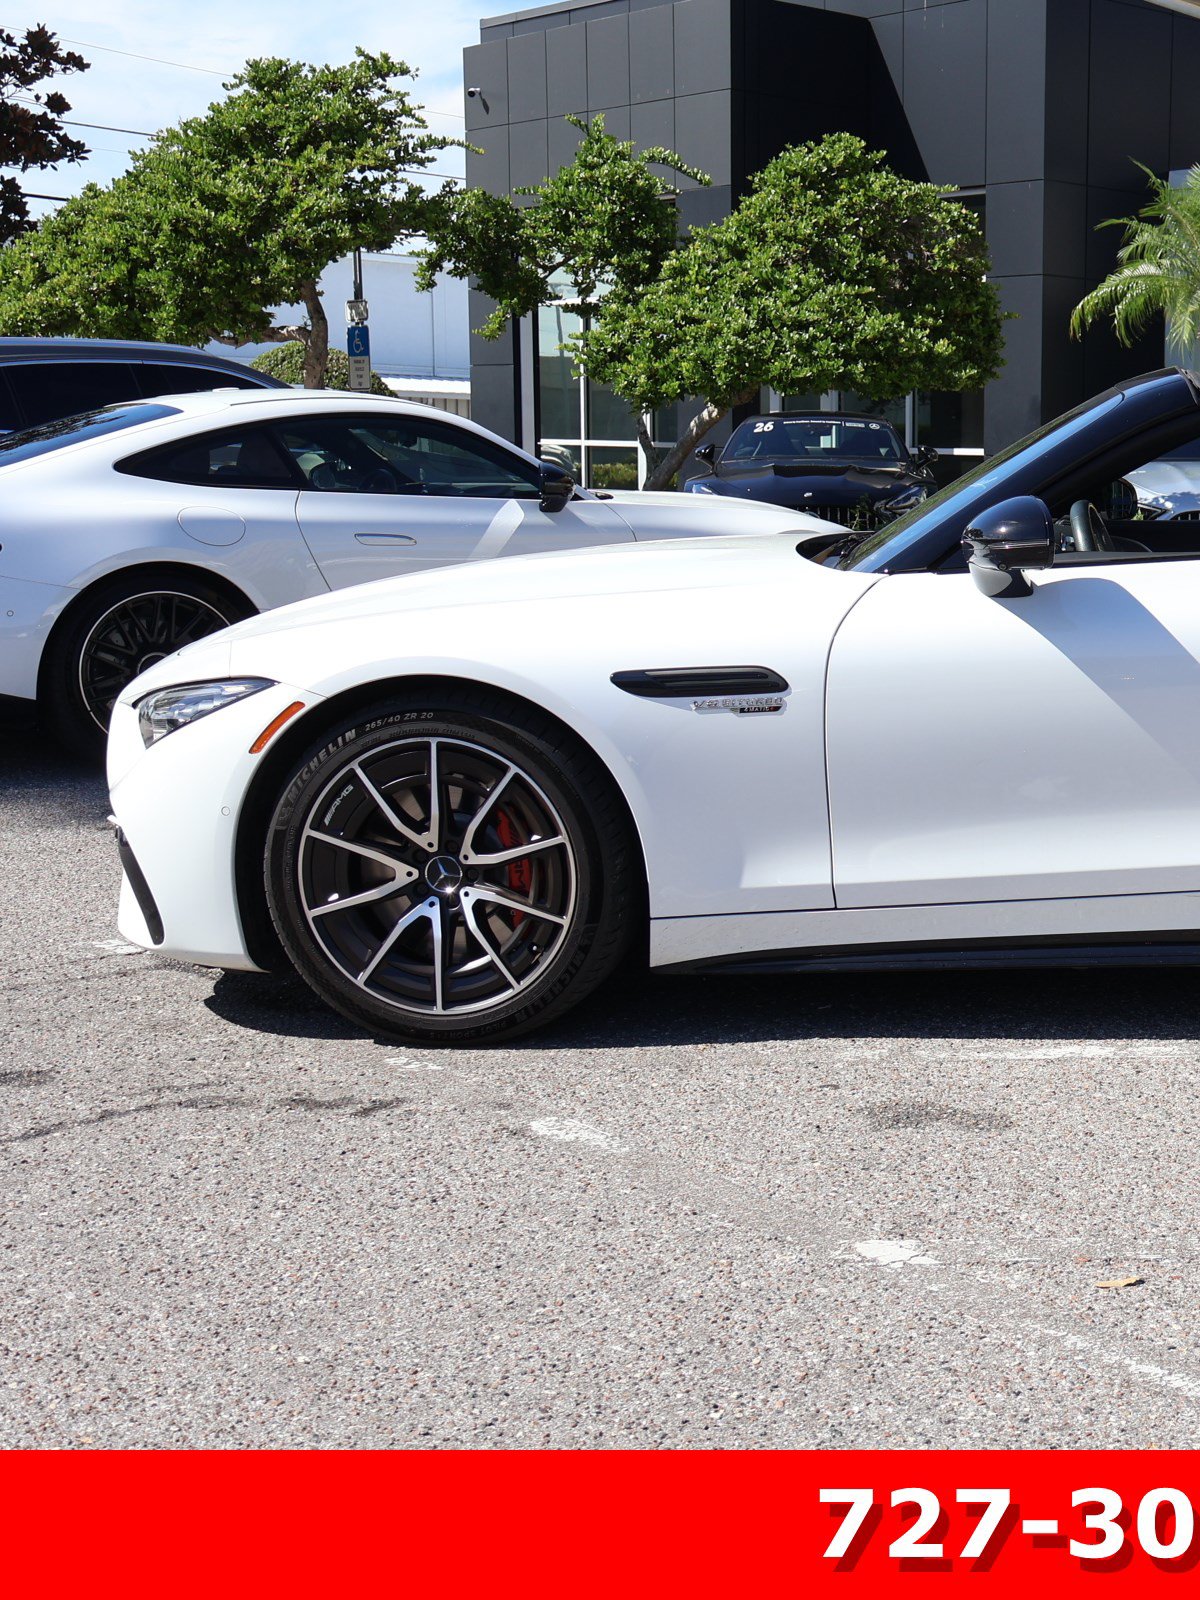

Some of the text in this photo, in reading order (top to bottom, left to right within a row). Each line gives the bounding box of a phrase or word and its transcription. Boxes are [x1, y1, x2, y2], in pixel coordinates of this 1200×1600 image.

[753, 421, 775, 433] 26
[287, 729, 356, 804] MICHELIN
[365, 714, 401, 732] 265/40
[404, 712, 417, 720] ZR
